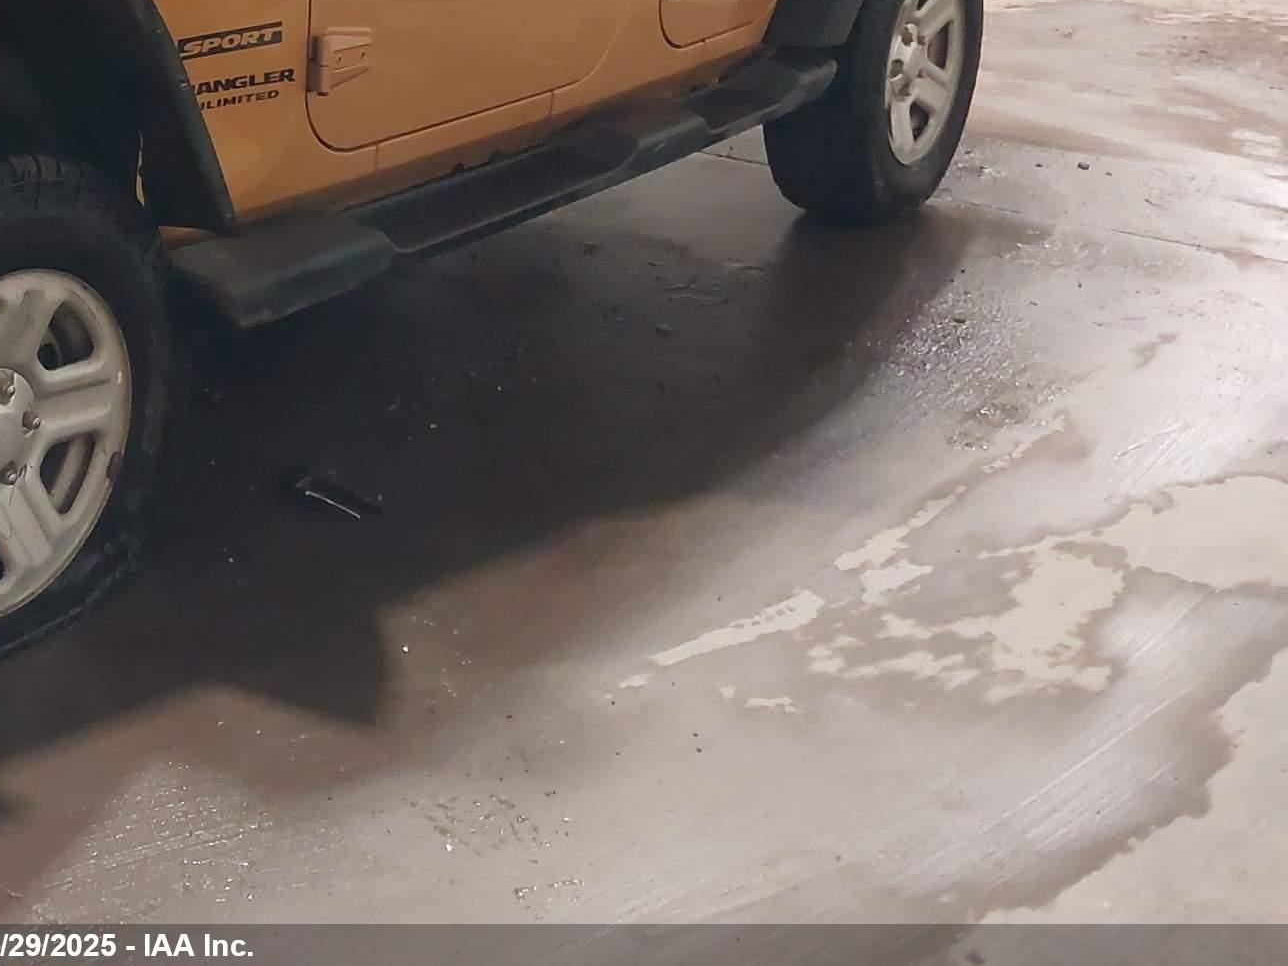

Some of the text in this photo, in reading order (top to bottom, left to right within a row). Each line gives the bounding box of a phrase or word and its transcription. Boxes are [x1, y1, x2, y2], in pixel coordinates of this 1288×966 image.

[182, 28, 277, 56] SPORT
[193, 68, 295, 95] ANGLER
[200, 90, 279, 110] LIMITED
